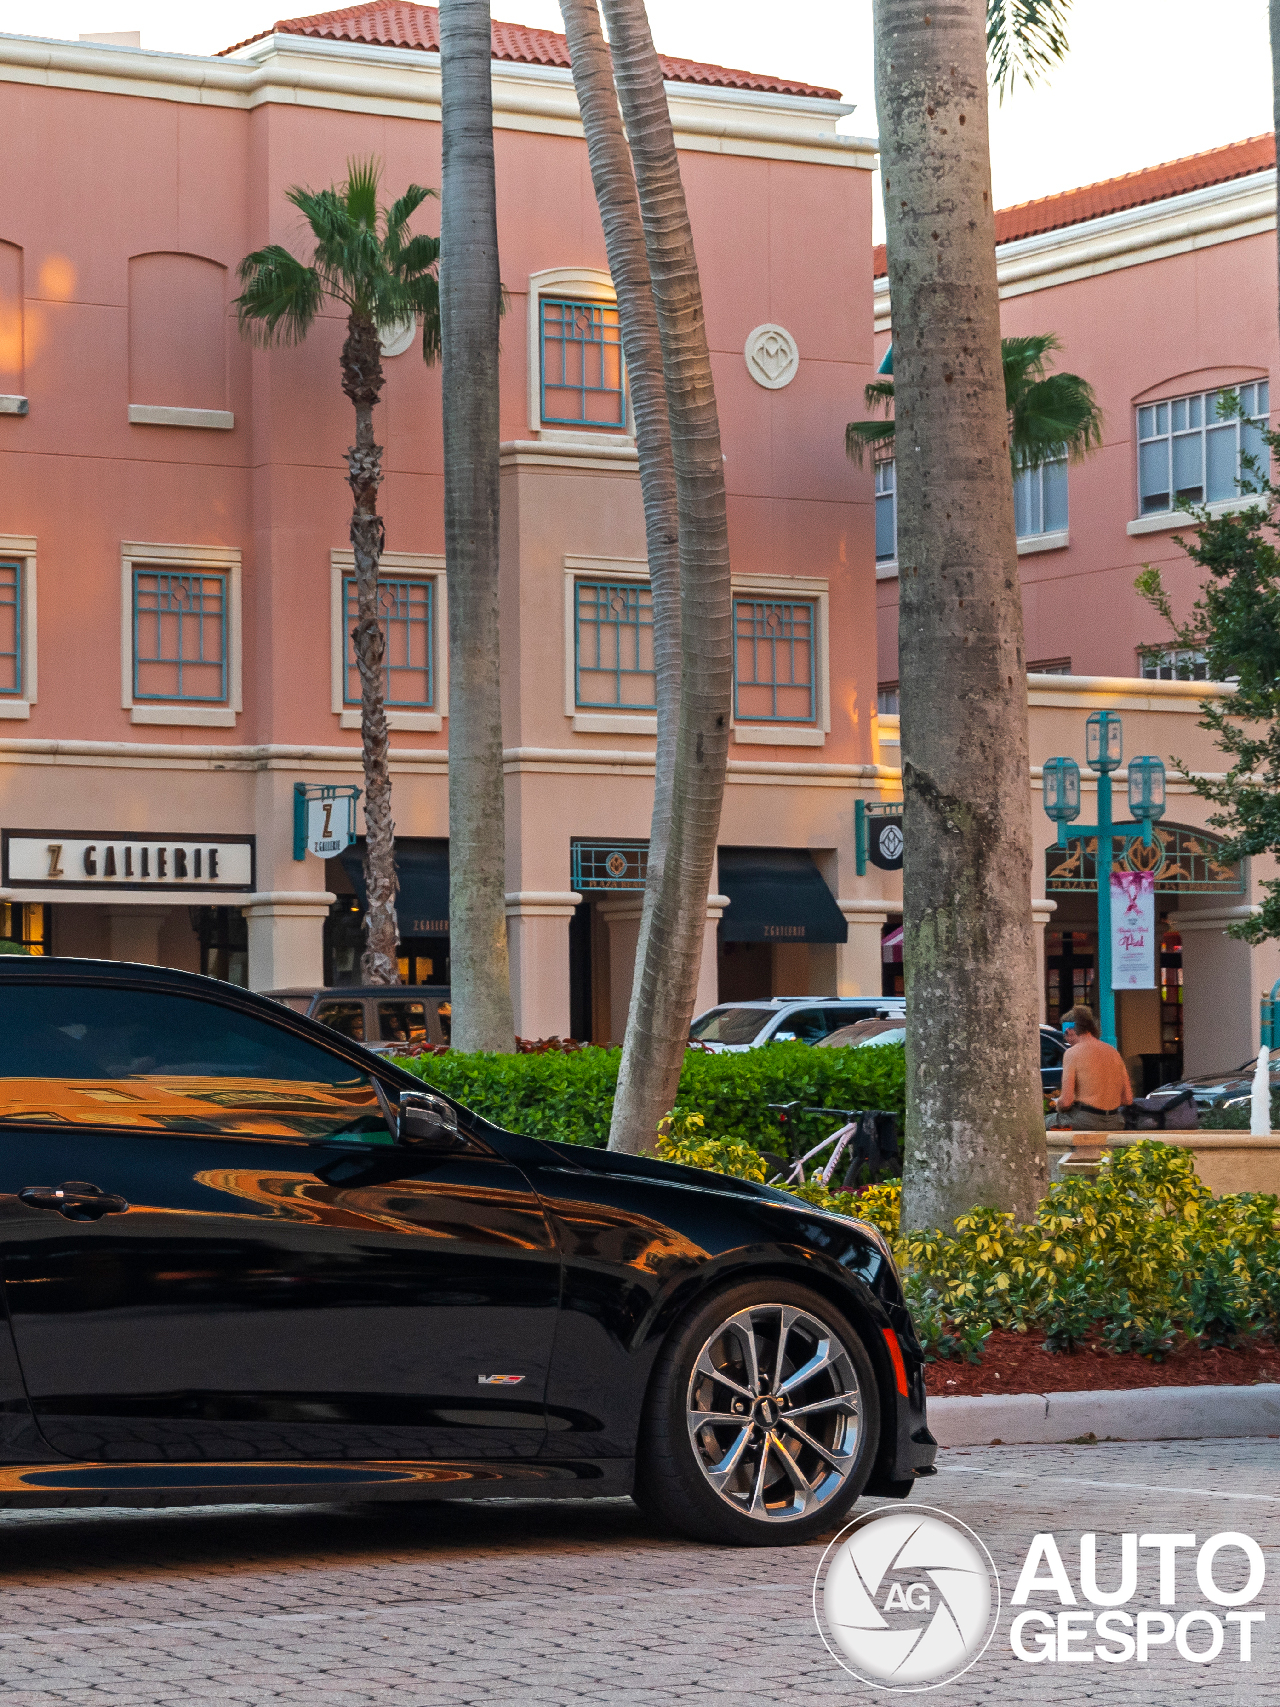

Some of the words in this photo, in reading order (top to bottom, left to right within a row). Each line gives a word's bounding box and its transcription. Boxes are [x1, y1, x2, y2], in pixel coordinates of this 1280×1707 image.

[322, 803, 333, 838] Z
[47, 843, 64, 877] Z
[83, 844, 219, 879] GALLERIE
